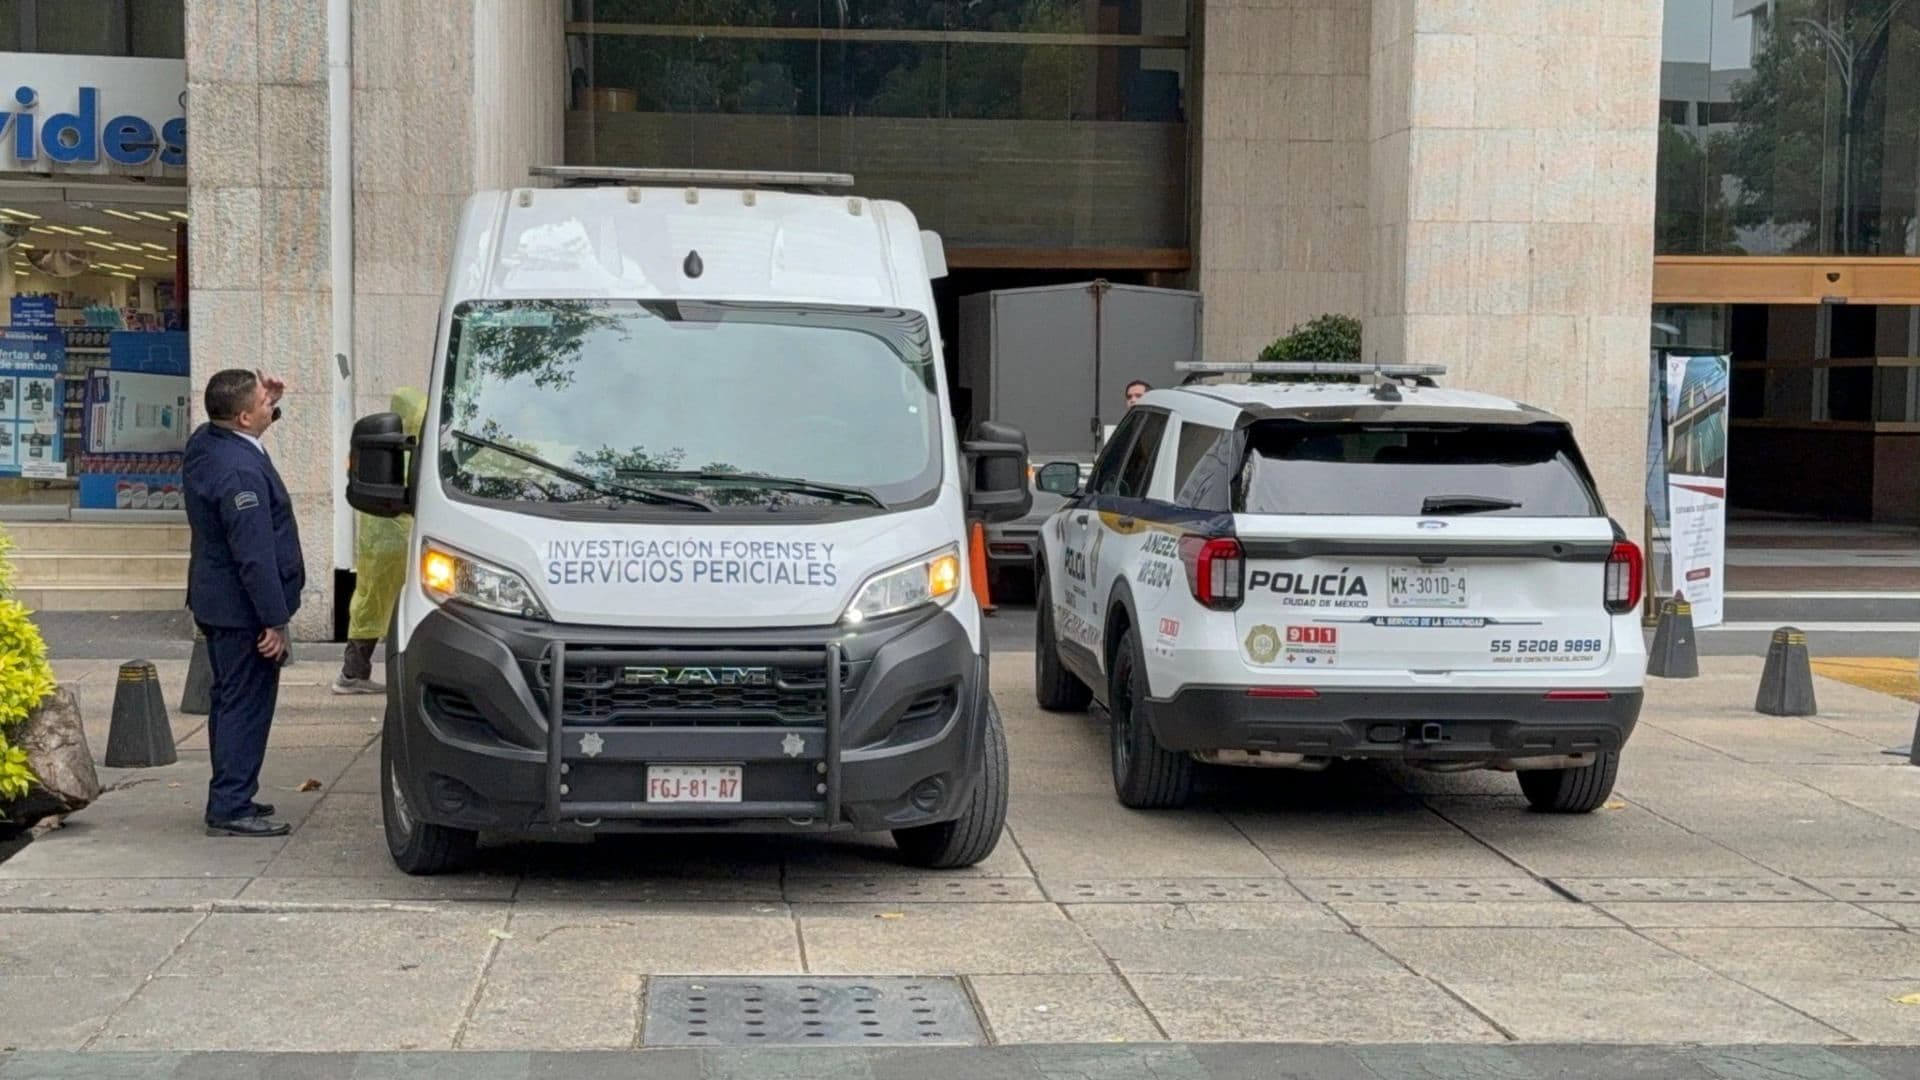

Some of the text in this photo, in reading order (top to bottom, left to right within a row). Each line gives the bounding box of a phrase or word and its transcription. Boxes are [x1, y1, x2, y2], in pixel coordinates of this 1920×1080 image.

[0, 86, 187, 166] ides
[549, 538, 835, 561] INVESTIGACIÓN FORENSE Y
[548, 560, 837, 586] SERVICIOS PERICIALES
[1248, 567, 1368, 597] POLICÍA
[1391, 577, 1466, 594] MX-301D-4
[1282, 597, 1316, 607] CIUDAD
[1319, 599, 1331, 607] DE
[1289, 628, 1332, 641] 911
[1490, 639, 1601, 652] 55 5208 9898
[624, 666, 767, 685] RAM
[651, 779, 738, 798] FGJ-81-A7
